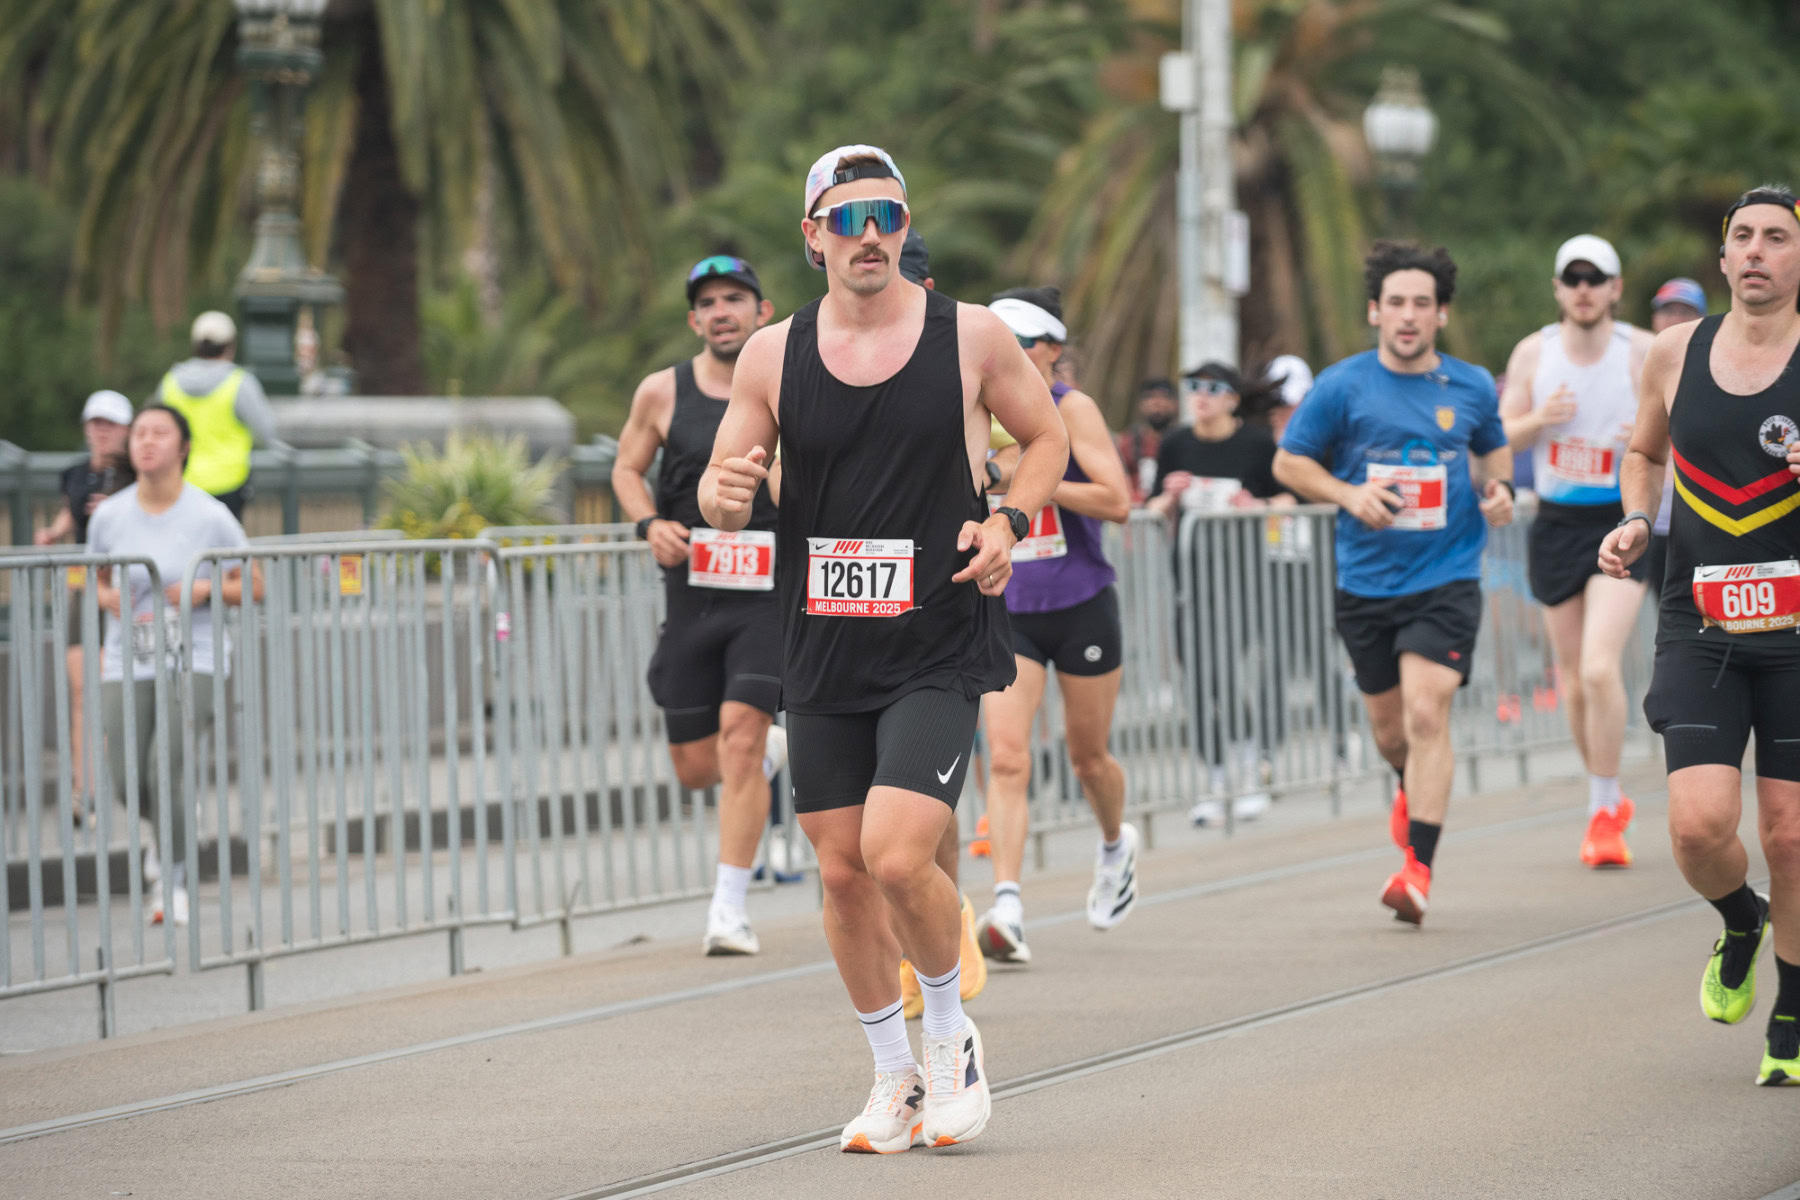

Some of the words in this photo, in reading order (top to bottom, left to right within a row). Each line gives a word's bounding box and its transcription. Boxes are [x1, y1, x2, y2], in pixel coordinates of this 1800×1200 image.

[705, 544, 759, 574] 7913
[821, 560, 897, 599] 12617
[815, 601, 870, 613] MELBOURNE
[872, 603, 901, 614] 2025
[1722, 581, 1776, 618] 609
[1768, 615, 1795, 628] 2025
